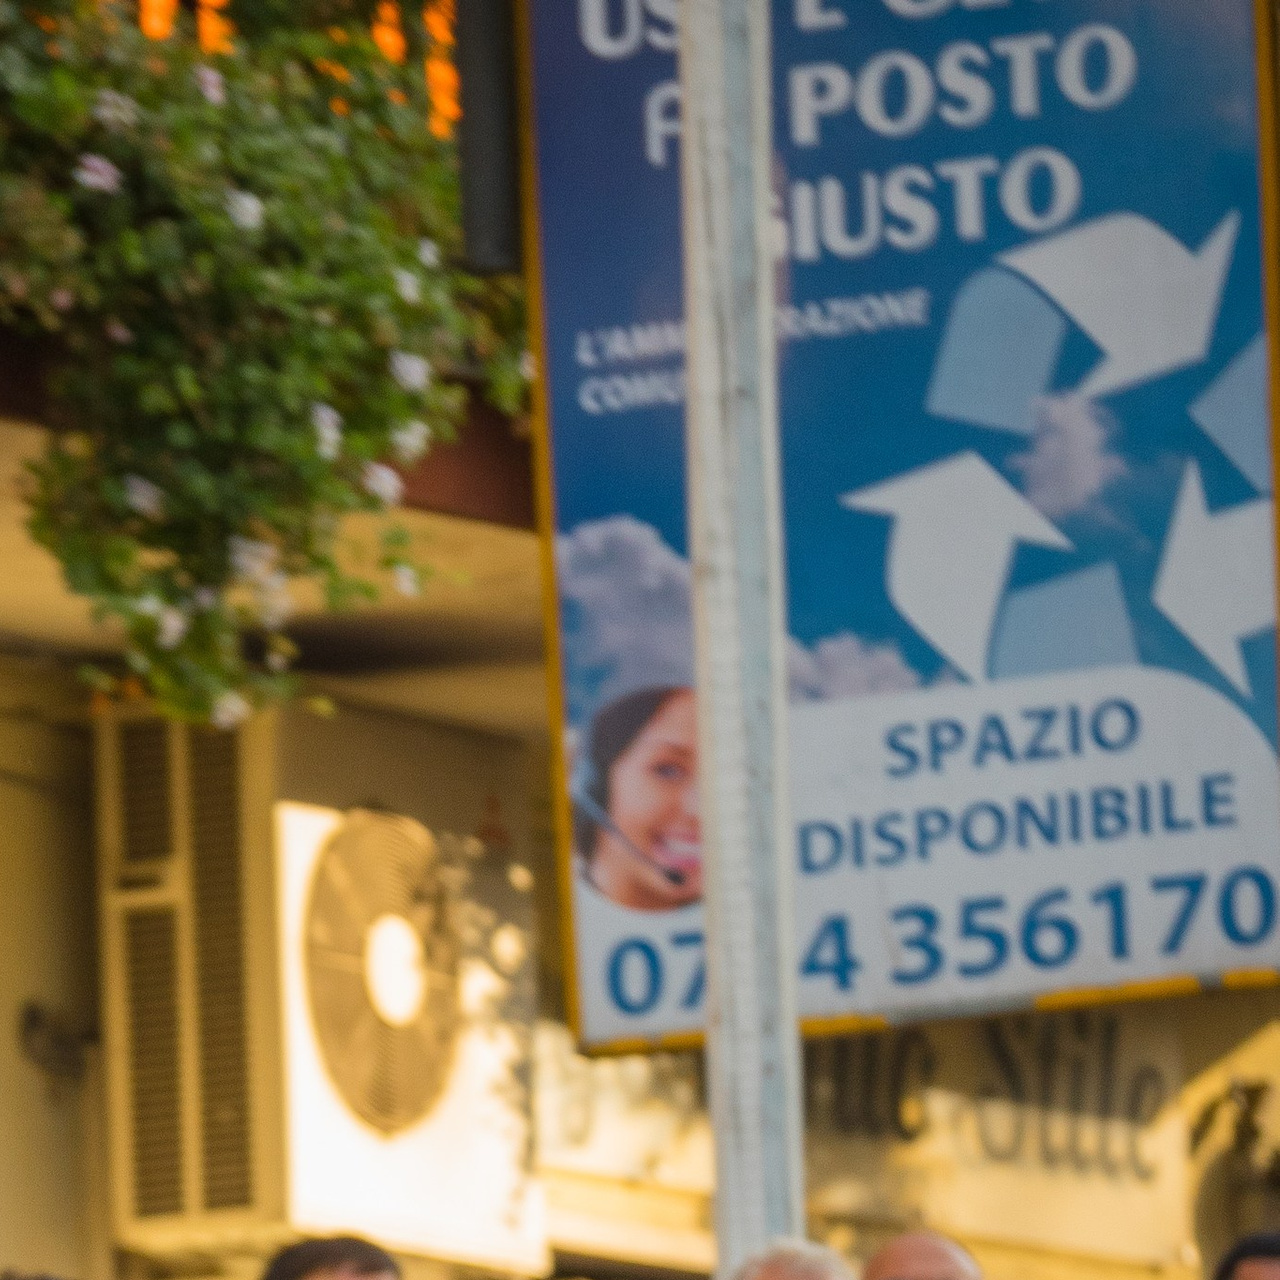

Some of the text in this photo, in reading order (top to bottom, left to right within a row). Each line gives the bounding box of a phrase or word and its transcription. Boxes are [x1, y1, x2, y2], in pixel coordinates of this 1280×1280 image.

[789, 23, 1138, 147] POSTO
[770, 148, 1083, 264] IUSTO
[883, 698, 1141, 778] SPAZIO
[797, 773, 1239, 876] DISPONIBILE
[606, 865, 1278, 1016] 074 356170
